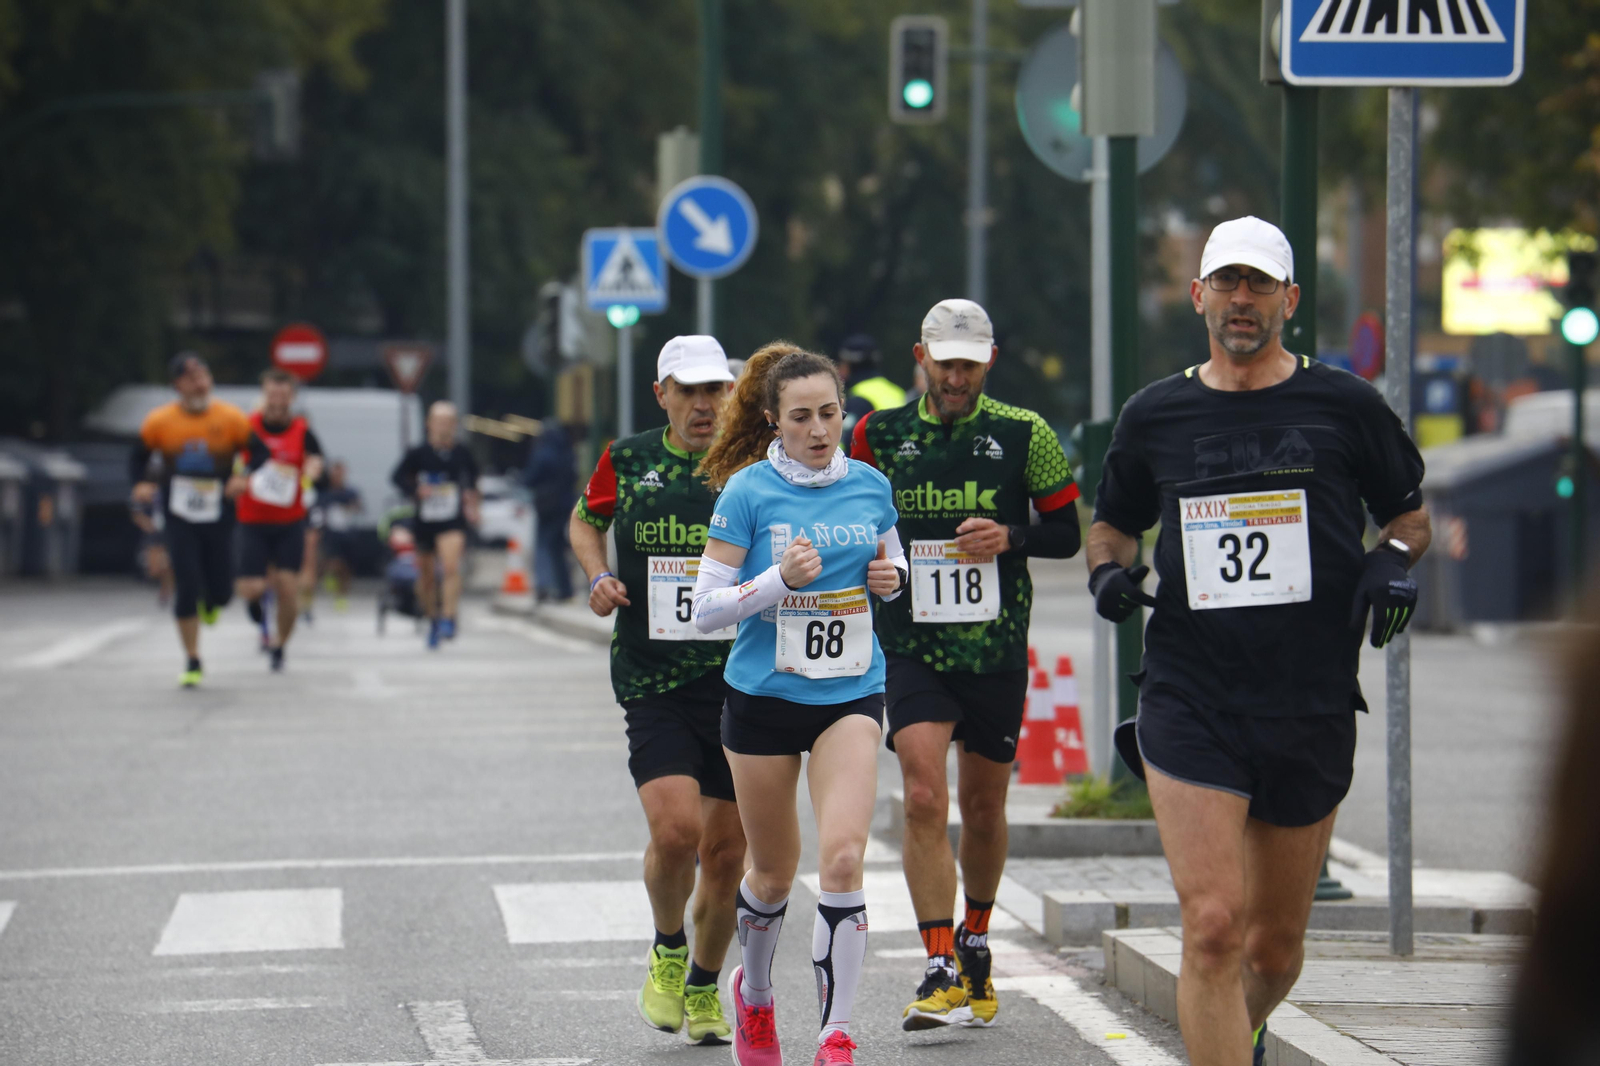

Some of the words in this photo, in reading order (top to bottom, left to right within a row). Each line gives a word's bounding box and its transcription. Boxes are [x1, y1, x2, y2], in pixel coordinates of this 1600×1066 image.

[1185, 499, 1229, 520] XXXIX
[1248, 515, 1302, 526] TRINITARIOS
[635, 514, 709, 546] Getba
[635, 544, 666, 553] Centro
[912, 544, 944, 557] XXXIX
[1218, 531, 1271, 583] 32
[652, 560, 686, 574] XXXIX
[930, 568, 983, 605] 118
[781, 594, 819, 609] XXXIX
[833, 606, 868, 616] TRINITARIOS
[805, 620, 846, 660] 68
